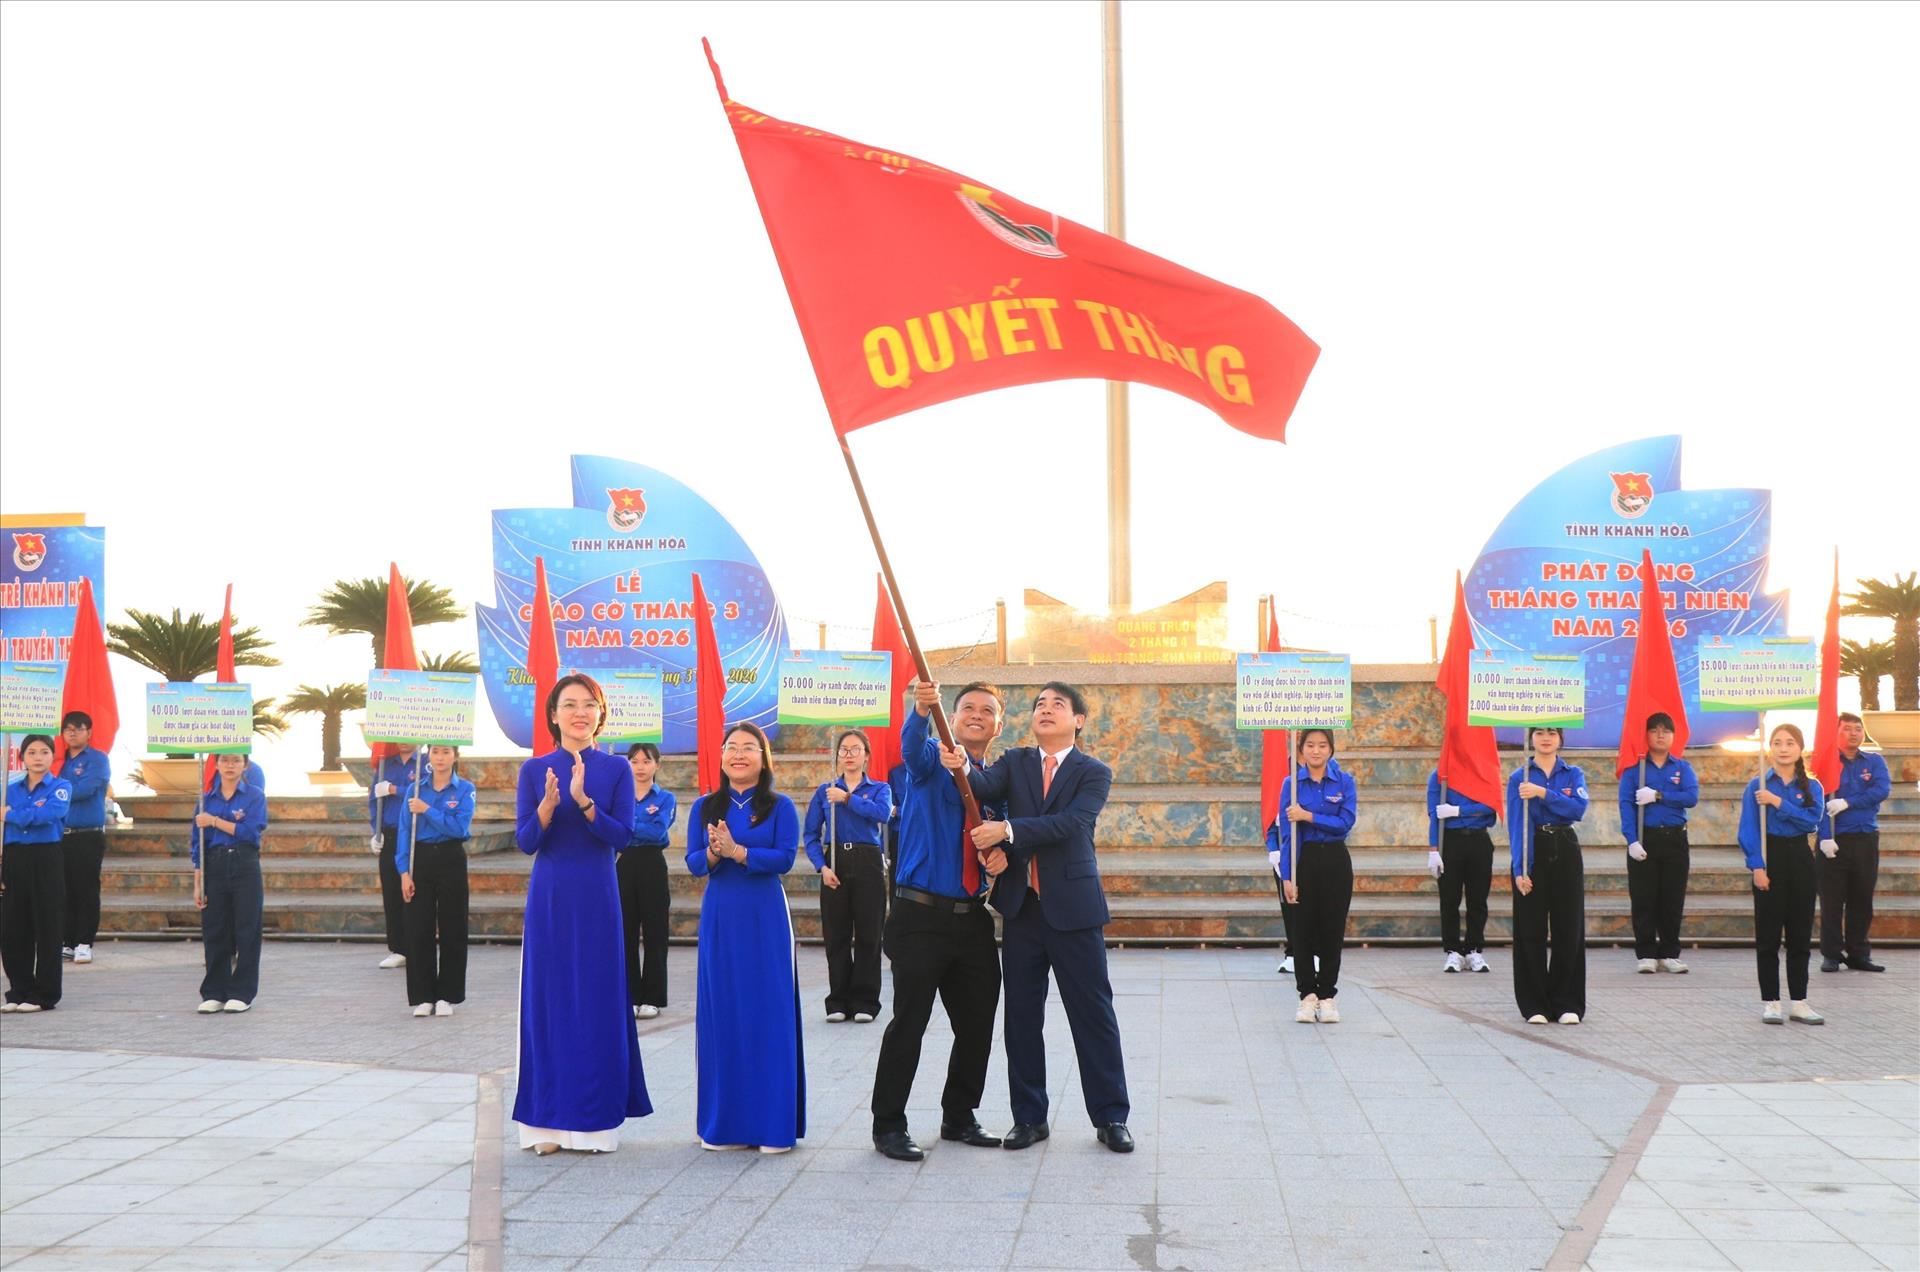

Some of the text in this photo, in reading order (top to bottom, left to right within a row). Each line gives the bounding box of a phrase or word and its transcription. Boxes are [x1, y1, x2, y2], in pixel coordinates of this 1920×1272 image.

[863, 277, 1064, 389] QUYẾT
[1542, 560, 1609, 581] PHÁT
[0, 576, 20, 608] TRẺ
[23, 577, 65, 608] KHÁNH
[1488, 586, 1578, 610] THÁNG
[1685, 588, 1749, 611] NIÊN
[518, 600, 585, 622] CÀO
[591, 600, 625, 622] CỜ
[724, 601, 740, 620] 3
[1553, 617, 1687, 638] NĂM 26
[566, 627, 691, 648] NĂM 2026
[1129, 636, 1136, 648] 2
[1701, 660, 1727, 670] 25.000
[685, 668, 693, 683] 3
[727, 667, 758, 684] 2026
[783, 677, 813, 688] 50.000
[1242, 675, 1251, 685] 10
[1474, 673, 1500, 684] 10.000
[152, 705, 179, 715] 40.000
[1264, 702, 1272, 712] 03
[1470, 700, 1490, 710] 2.000
